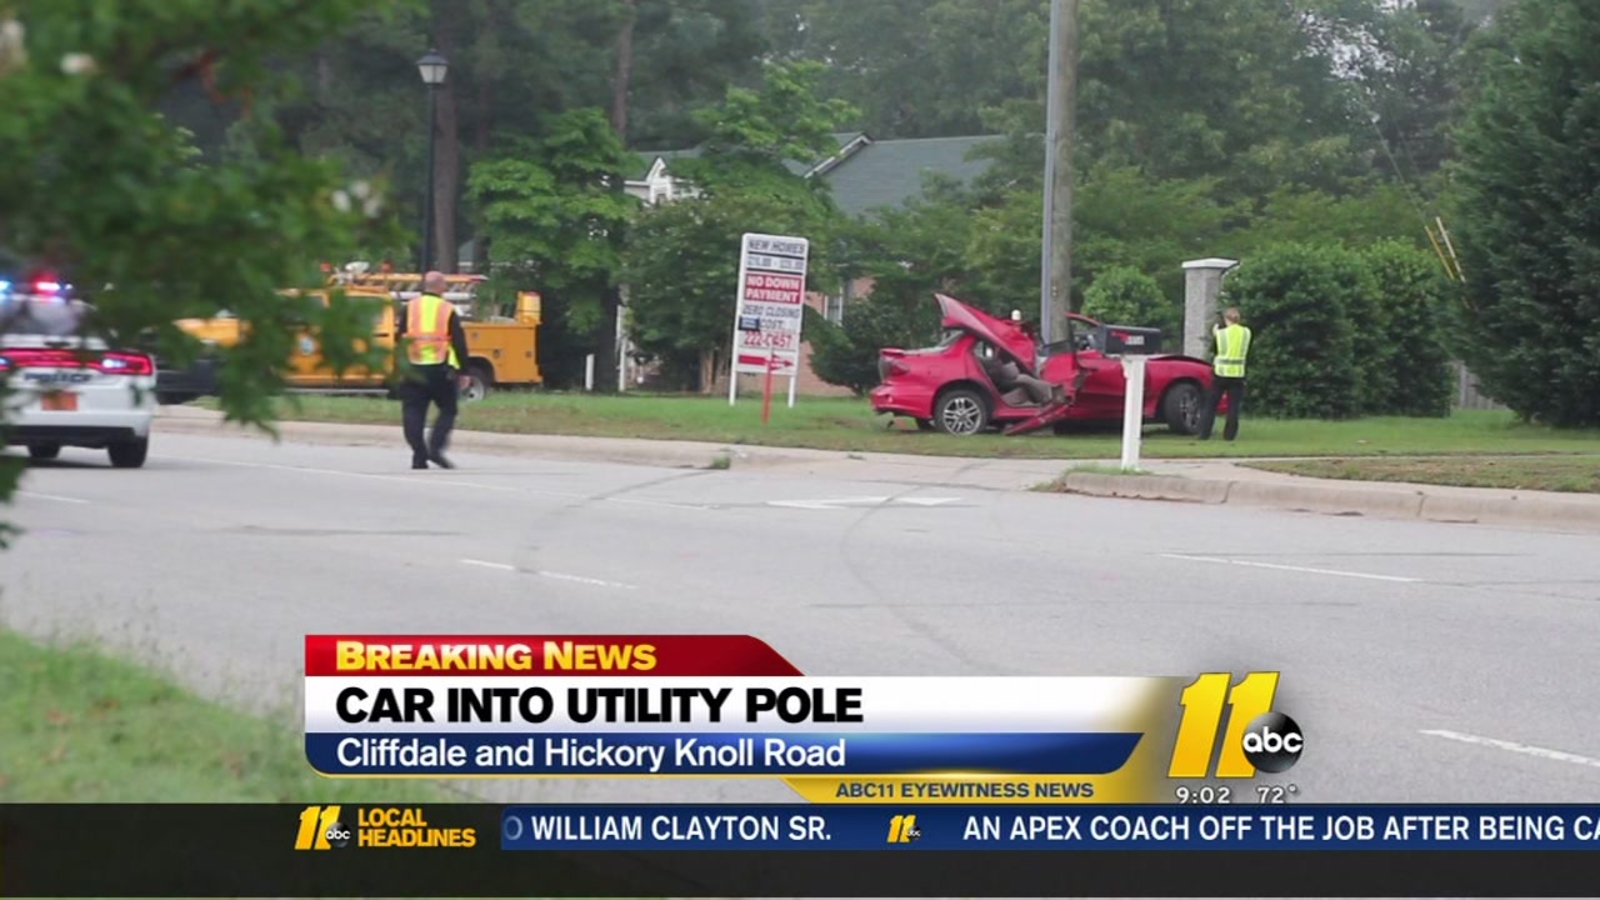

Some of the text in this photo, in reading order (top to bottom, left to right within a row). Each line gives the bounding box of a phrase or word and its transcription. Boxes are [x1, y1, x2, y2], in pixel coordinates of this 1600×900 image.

[748, 240, 806, 254] NEW HOMES
[747, 275, 801, 291] NO DOWN
[746, 287, 799, 302] PAYMENT
